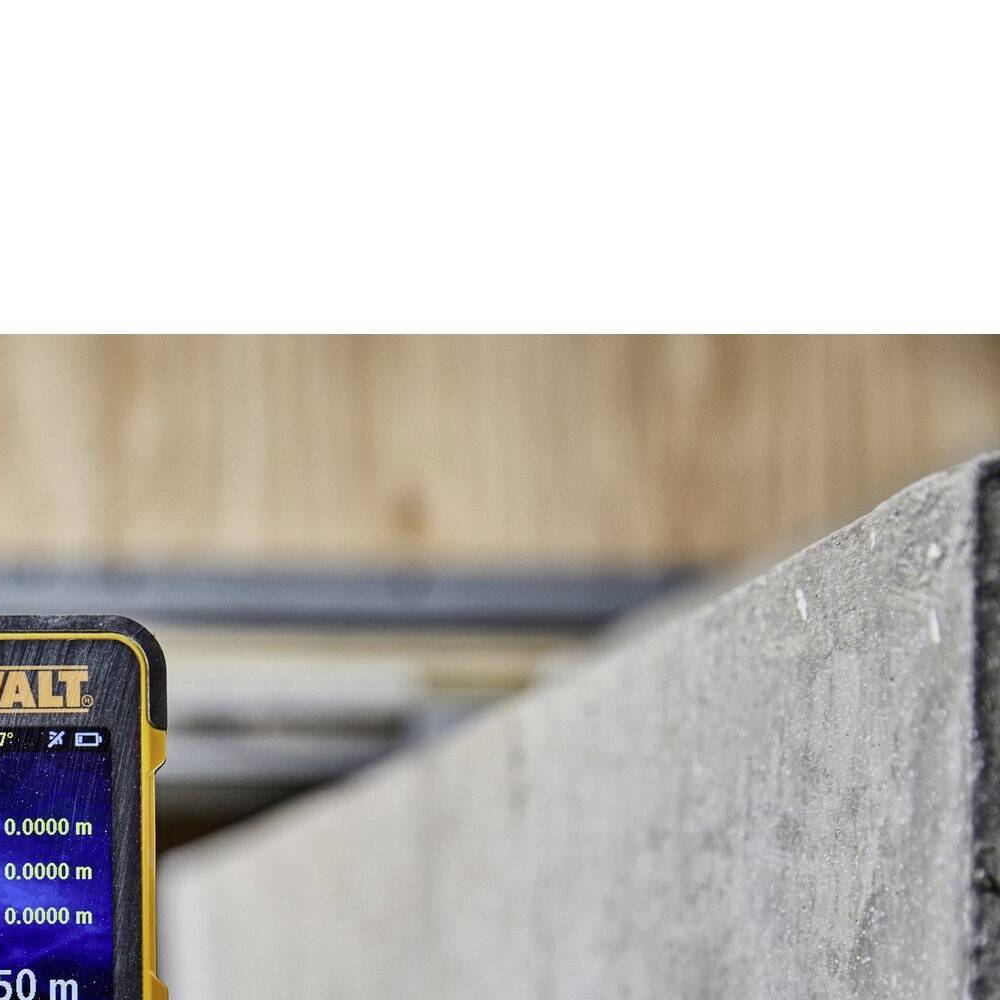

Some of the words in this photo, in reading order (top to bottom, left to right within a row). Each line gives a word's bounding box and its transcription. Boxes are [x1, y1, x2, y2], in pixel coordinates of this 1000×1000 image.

[4, 818, 70, 836] 0.0000
[75, 821, 93, 836] m
[4, 862, 70, 880] 0.0000
[75, 866, 93, 880] m
[4, 907, 70, 925] 0.0000
[75, 910, 93, 925] m
[49, 979, 79, 1000] m
